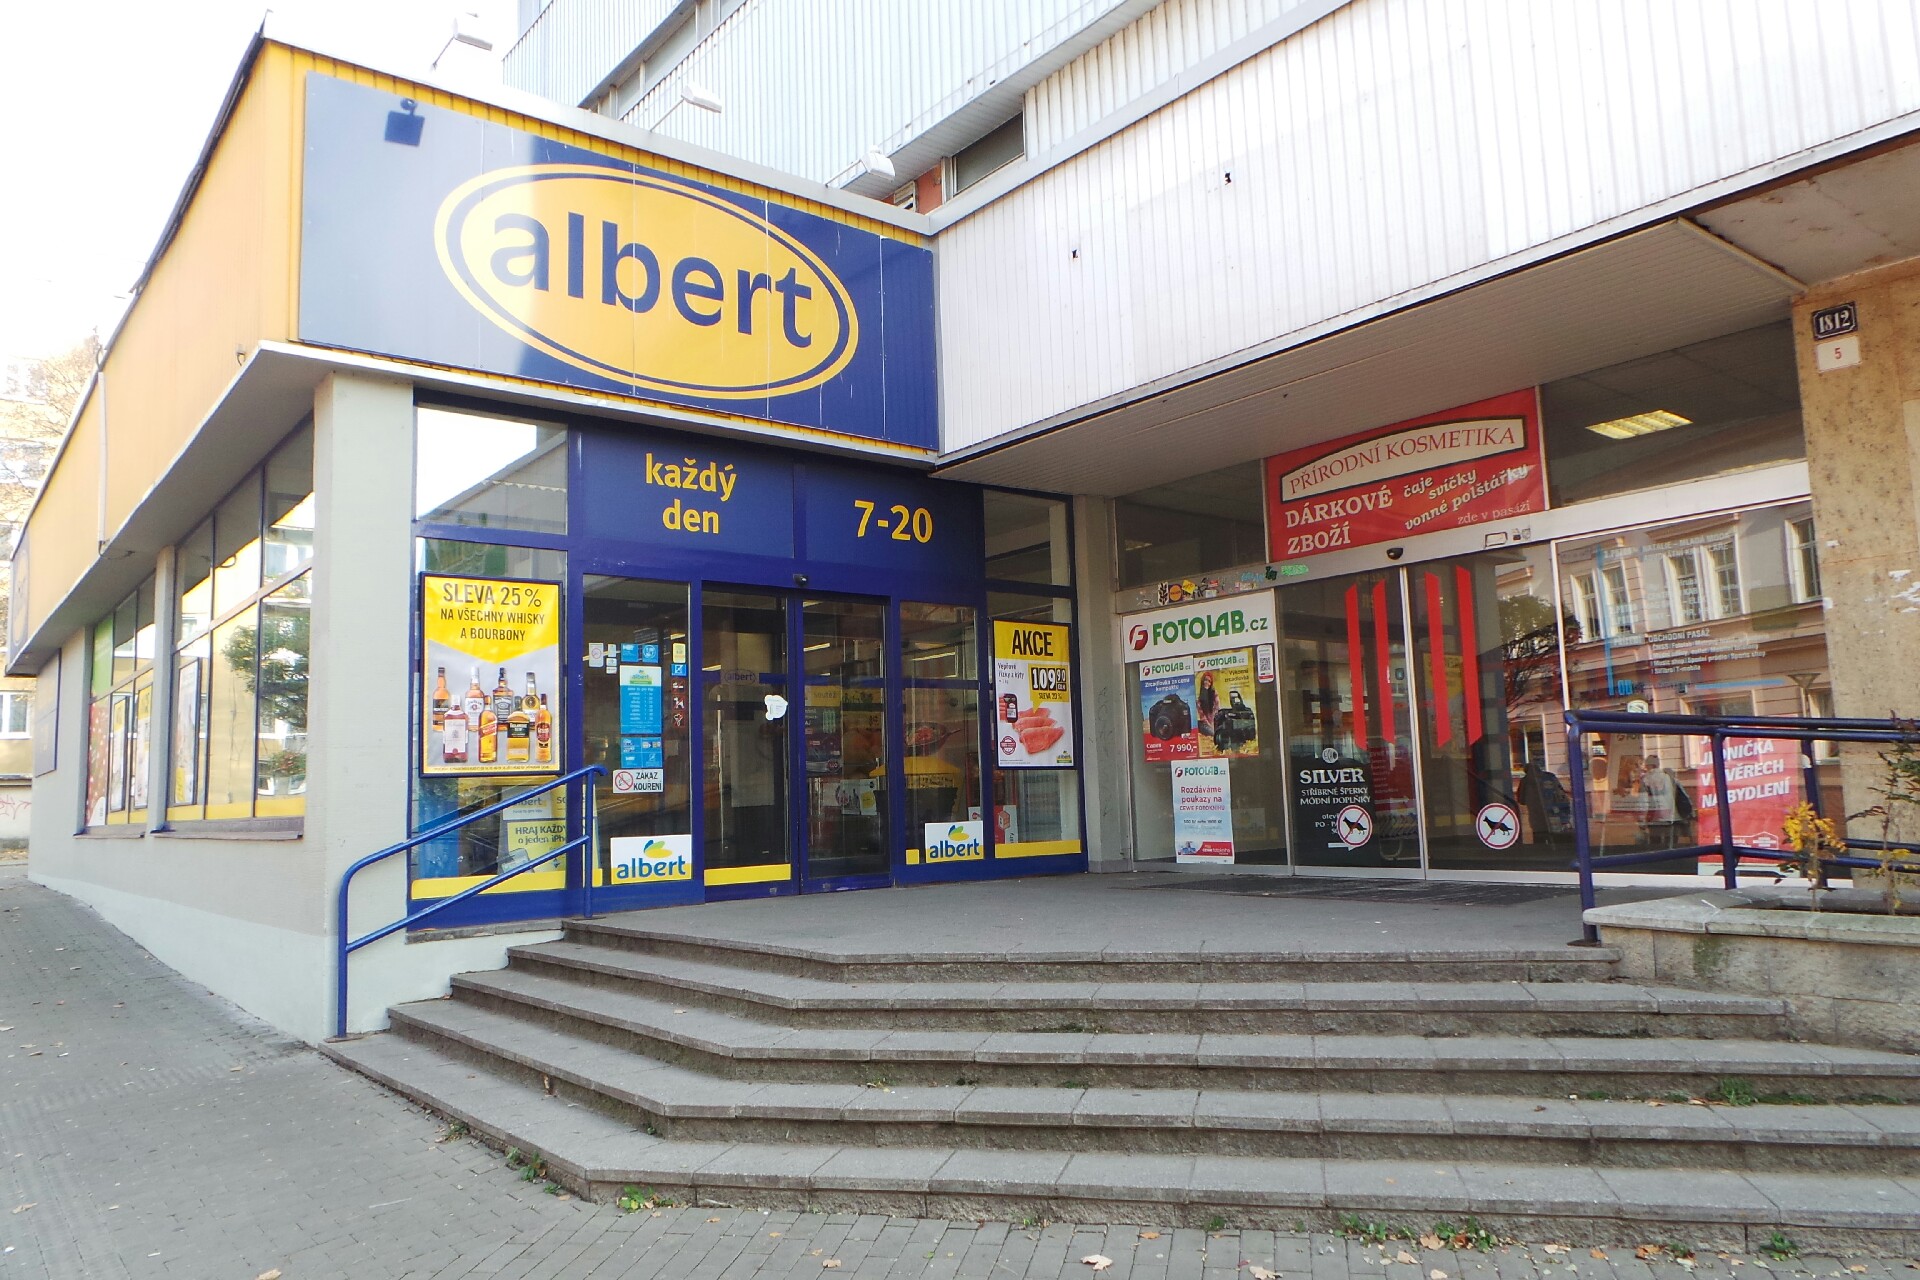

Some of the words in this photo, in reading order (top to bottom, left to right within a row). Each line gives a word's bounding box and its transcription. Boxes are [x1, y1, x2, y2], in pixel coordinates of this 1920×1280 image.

[490, 211, 812, 348] albert
[1819, 309, 1851, 333] 1812
[1834, 347, 1842, 359] 5
[1290, 442, 1381, 494] PŘÍRODNÍ
[1386, 427, 1515, 461] KOSMETIKA
[645, 452, 737, 502] každý
[1403, 475, 1434, 498] čaje
[1428, 468, 1477, 500] svíčky
[1285, 484, 1393, 529] DÁRKOVÉ
[1405, 499, 1448, 530] vonné
[1451, 462, 1529, 513] polštářky
[662, 499, 719, 534] den
[854, 499, 933, 544] 7-20
[1458, 510, 1479, 525] zde
[1481, 511, 1489, 519] v
[1491, 499, 1531, 521] pasáži
[1287, 520, 1351, 555] ZBOŽÍ
[443, 582, 495, 605] SLEVA
[500, 586, 521, 606] 25
[525, 588, 541, 607] %
[440, 608, 454, 620] NA
[457, 607, 504, 623] VŠECHNY
[507, 612, 545, 625] WHISKY
[1153, 610, 1268, 645] FOTOLAB.cz
[460, 628, 467, 639] A
[470, 628, 526, 641] BOURBONY
[1011, 629, 1054, 656] AKCE
[1032, 668, 1056, 689] 109
[635, 770, 659, 780] ZÁKAZ
[1299, 767, 1366, 784] SILVER
[1725, 758, 1785, 783] VĚRECH
[633, 780, 662, 791] KOUŘENÍ
[1181, 784, 1222, 794] Rozdáváme
[1301, 786, 1339, 796] STŘÍBRNÉ
[1340, 786, 1369, 795] ŠPERKY
[1300, 796, 1331, 806] MÓDNÍ
[1333, 794, 1371, 804] DOPLŇKY
[515, 826, 538, 836] HRAJ
[525, 836, 550, 845] jeden
[929, 838, 980, 859] albert
[616, 854, 686, 880] albert
